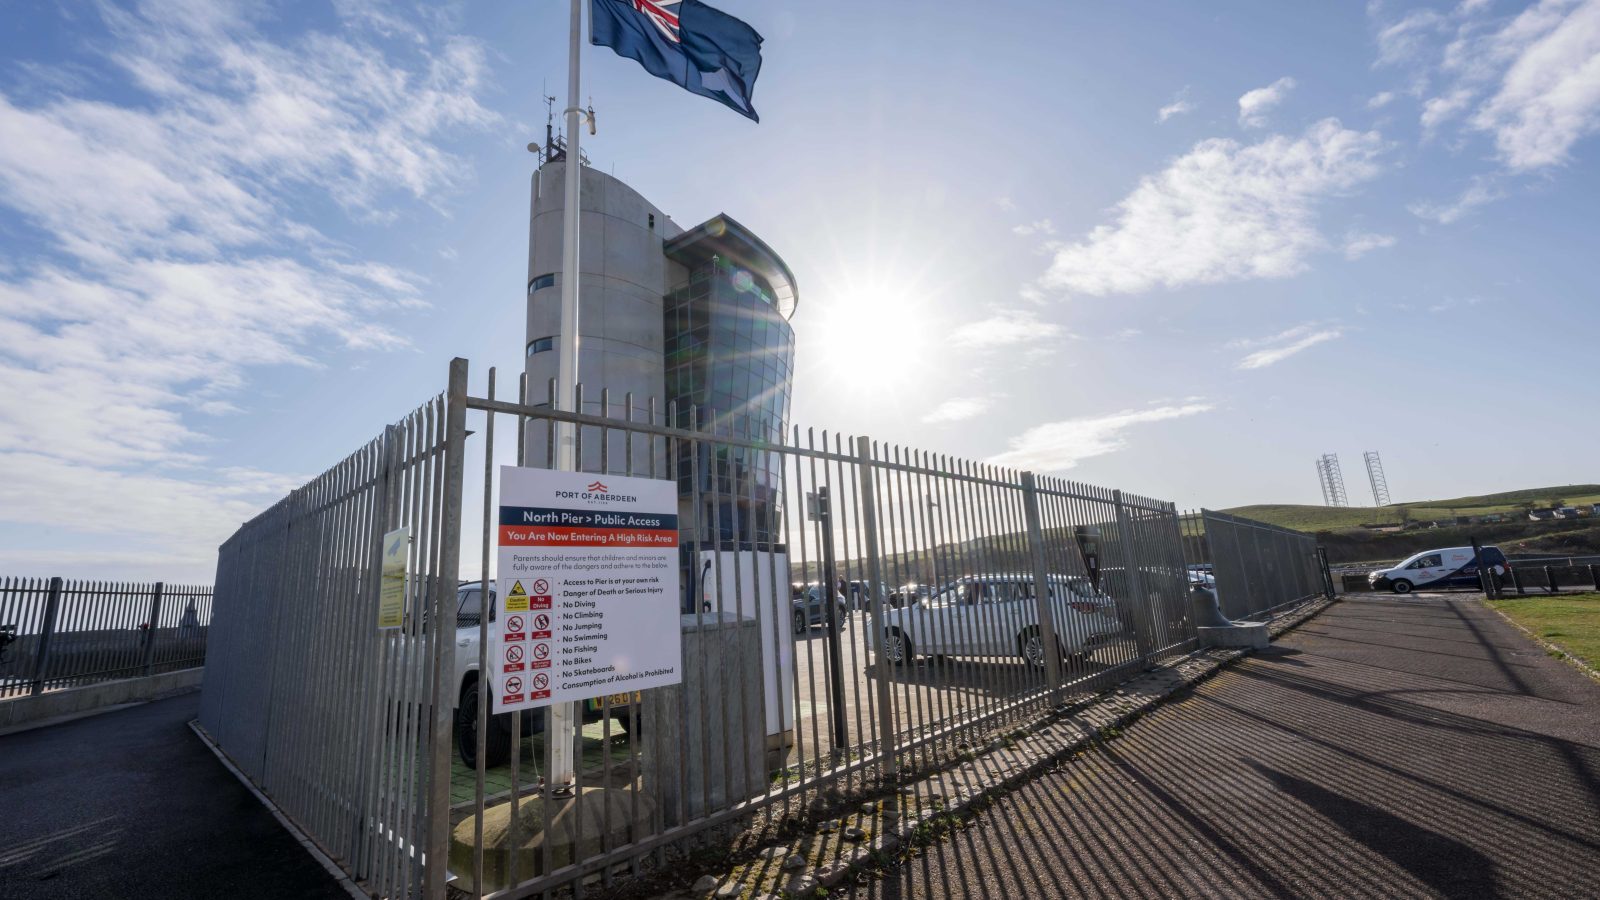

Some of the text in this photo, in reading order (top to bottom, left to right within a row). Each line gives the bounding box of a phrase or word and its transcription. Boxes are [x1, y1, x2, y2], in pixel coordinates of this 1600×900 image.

[594, 494, 636, 502] ABERDEEN
[524, 511, 558, 522] North
[562, 513, 583, 523] Pier
[595, 514, 625, 525] Public
[628, 516, 660, 526] Access
[508, 531, 525, 540] You
[528, 531, 545, 540] Are
[548, 532, 568, 540] Now
[571, 533, 606, 543] Entering
[617, 534, 635, 543] High
[513, 564, 528, 572] fully
[574, 633, 607, 642] Swimming
[574, 645, 597, 653] Fishing
[574, 665, 615, 676] Skateboards
[562, 678, 606, 690] Consumption
[615, 672, 638, 682] Alcohol
[645, 667, 674, 677] Prohibited
